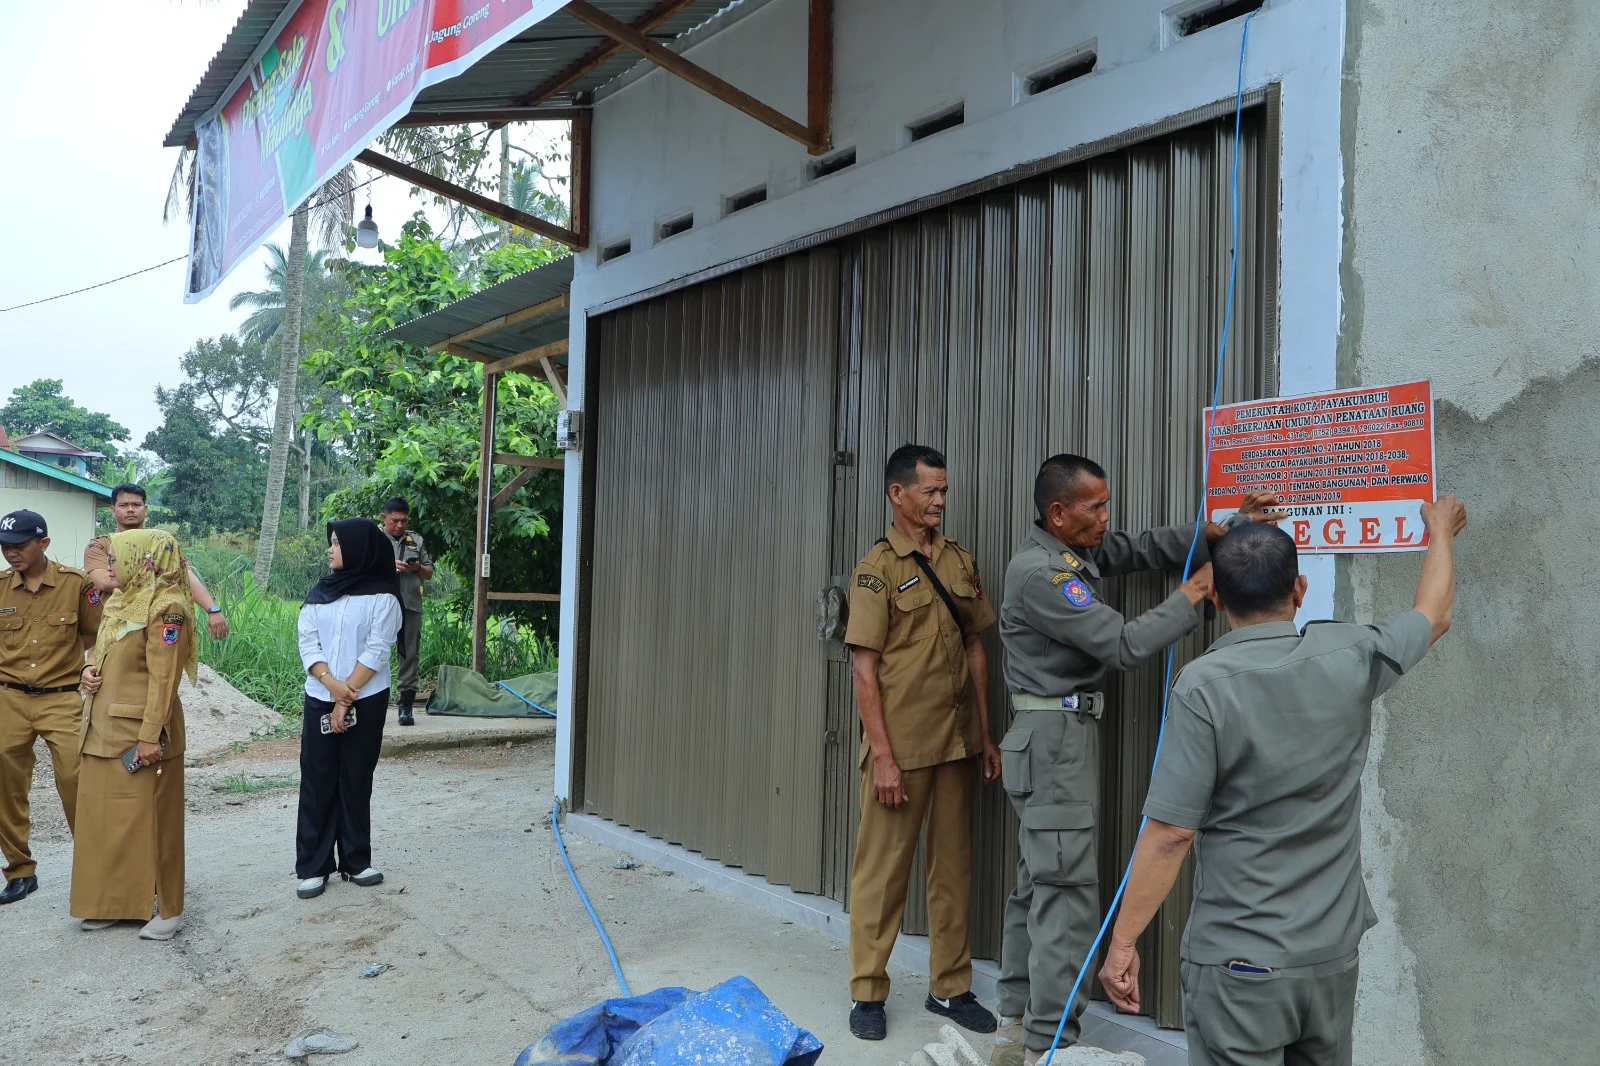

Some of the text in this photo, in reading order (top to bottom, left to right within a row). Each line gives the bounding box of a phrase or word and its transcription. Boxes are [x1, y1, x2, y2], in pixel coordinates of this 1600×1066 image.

[428, 3, 490, 43] Jagung Goreng
[1235, 392, 1389, 420] PEMERINTAH KOTA PAYAKUMBUH
[1209, 403, 1425, 437] DINAS PEKERJAAN UMUM DAN PENATAAN RUANG
[1272, 433, 1285, 441] No.
[1312, 428, 1332, 438] (0752)
[1359, 423, 1385, 432] 796022
[1386, 421, 1401, 429] Fax.
[1241, 439, 1382, 460] BERDASARKAN PERDA NO. 2 TAHUN 2018
[1222, 450, 1409, 473] TENTANG RDTR KOTA PAYAKUMBUH TAHUN 2018-2038,
[1208, 487, 1226, 496] PERDA
[1226, 486, 1238, 495] NO.
[1270, 483, 1286, 492] 2011
[1289, 481, 1320, 491] TENTANG
[1322, 477, 1370, 489] BANGUNAN,
[1371, 476, 1389, 486] DAN
[1391, 473, 1429, 485] PERWAKO
[1236, 464, 1389, 483] PERDA NOMOR 3 TAHUN 2018 TENTANG IMB,
[1275, 492, 1341, 503] O. 82 TAHUN 2019
[1326, 505, 1345, 515] INI
[1268, 516, 1414, 546] EGEL
